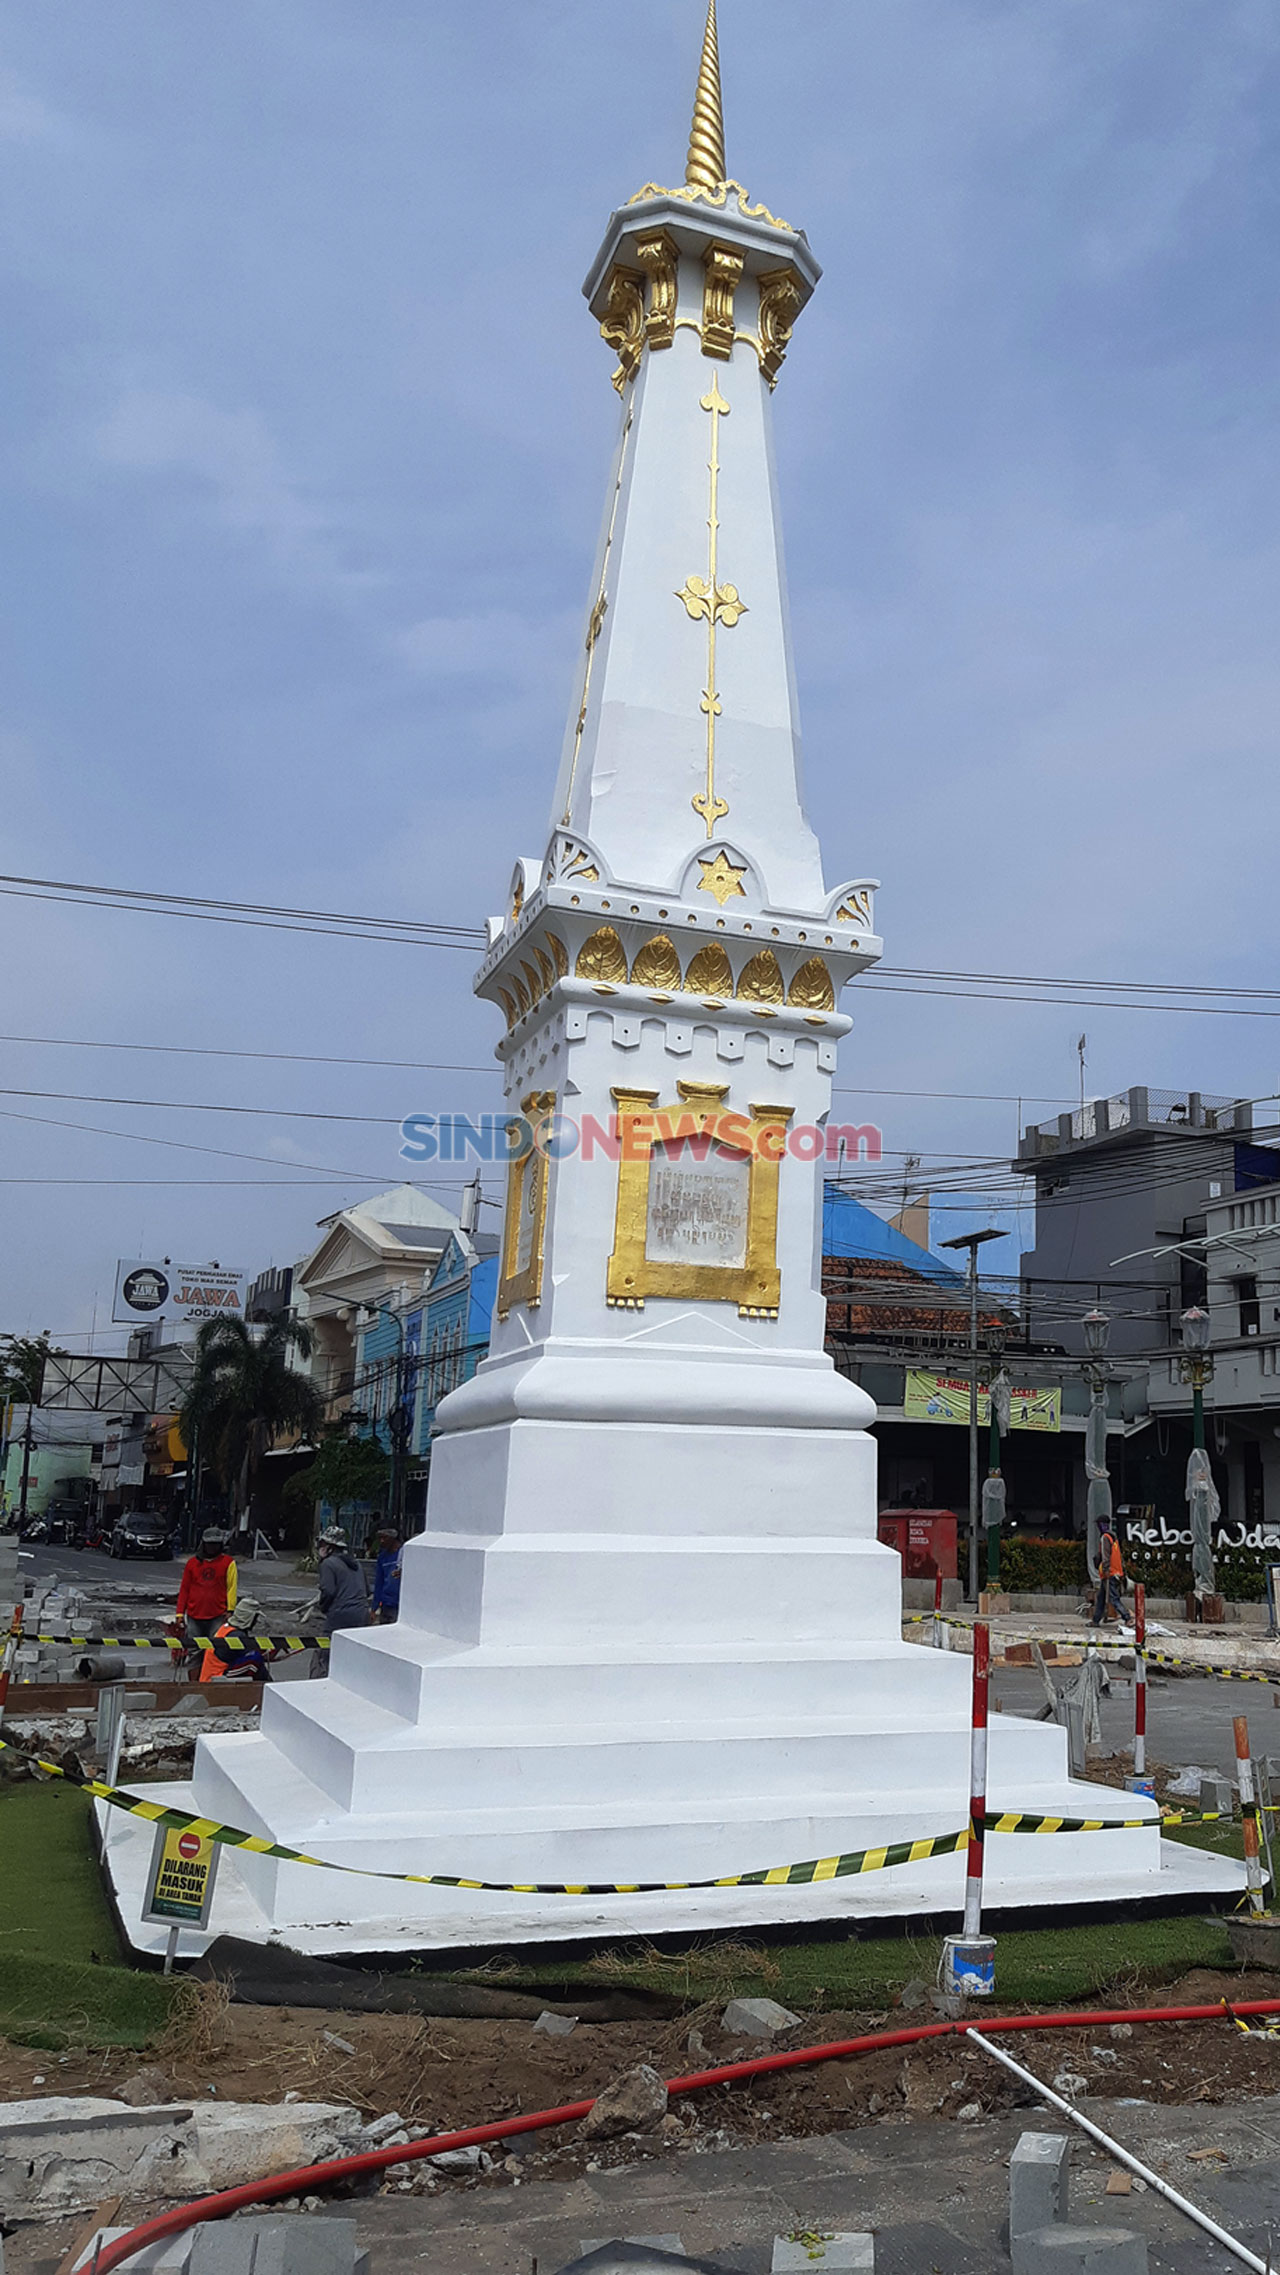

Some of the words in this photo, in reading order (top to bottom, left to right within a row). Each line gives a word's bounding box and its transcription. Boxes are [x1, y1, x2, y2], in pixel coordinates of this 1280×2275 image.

[132, 1285, 159, 1297] JAWA
[173, 1286, 241, 1308] JAWA
[187, 1308, 225, 1318] JOGJA
[1126, 1516, 1212, 1547] Kebo
[1131, 1552, 1192, 1561] COFFE
[163, 1858, 207, 1879] DILARANG
[160, 1874, 204, 1893] MASUK
[158, 1887, 166, 1897] DI
[166, 1889, 181, 1900] AREA
